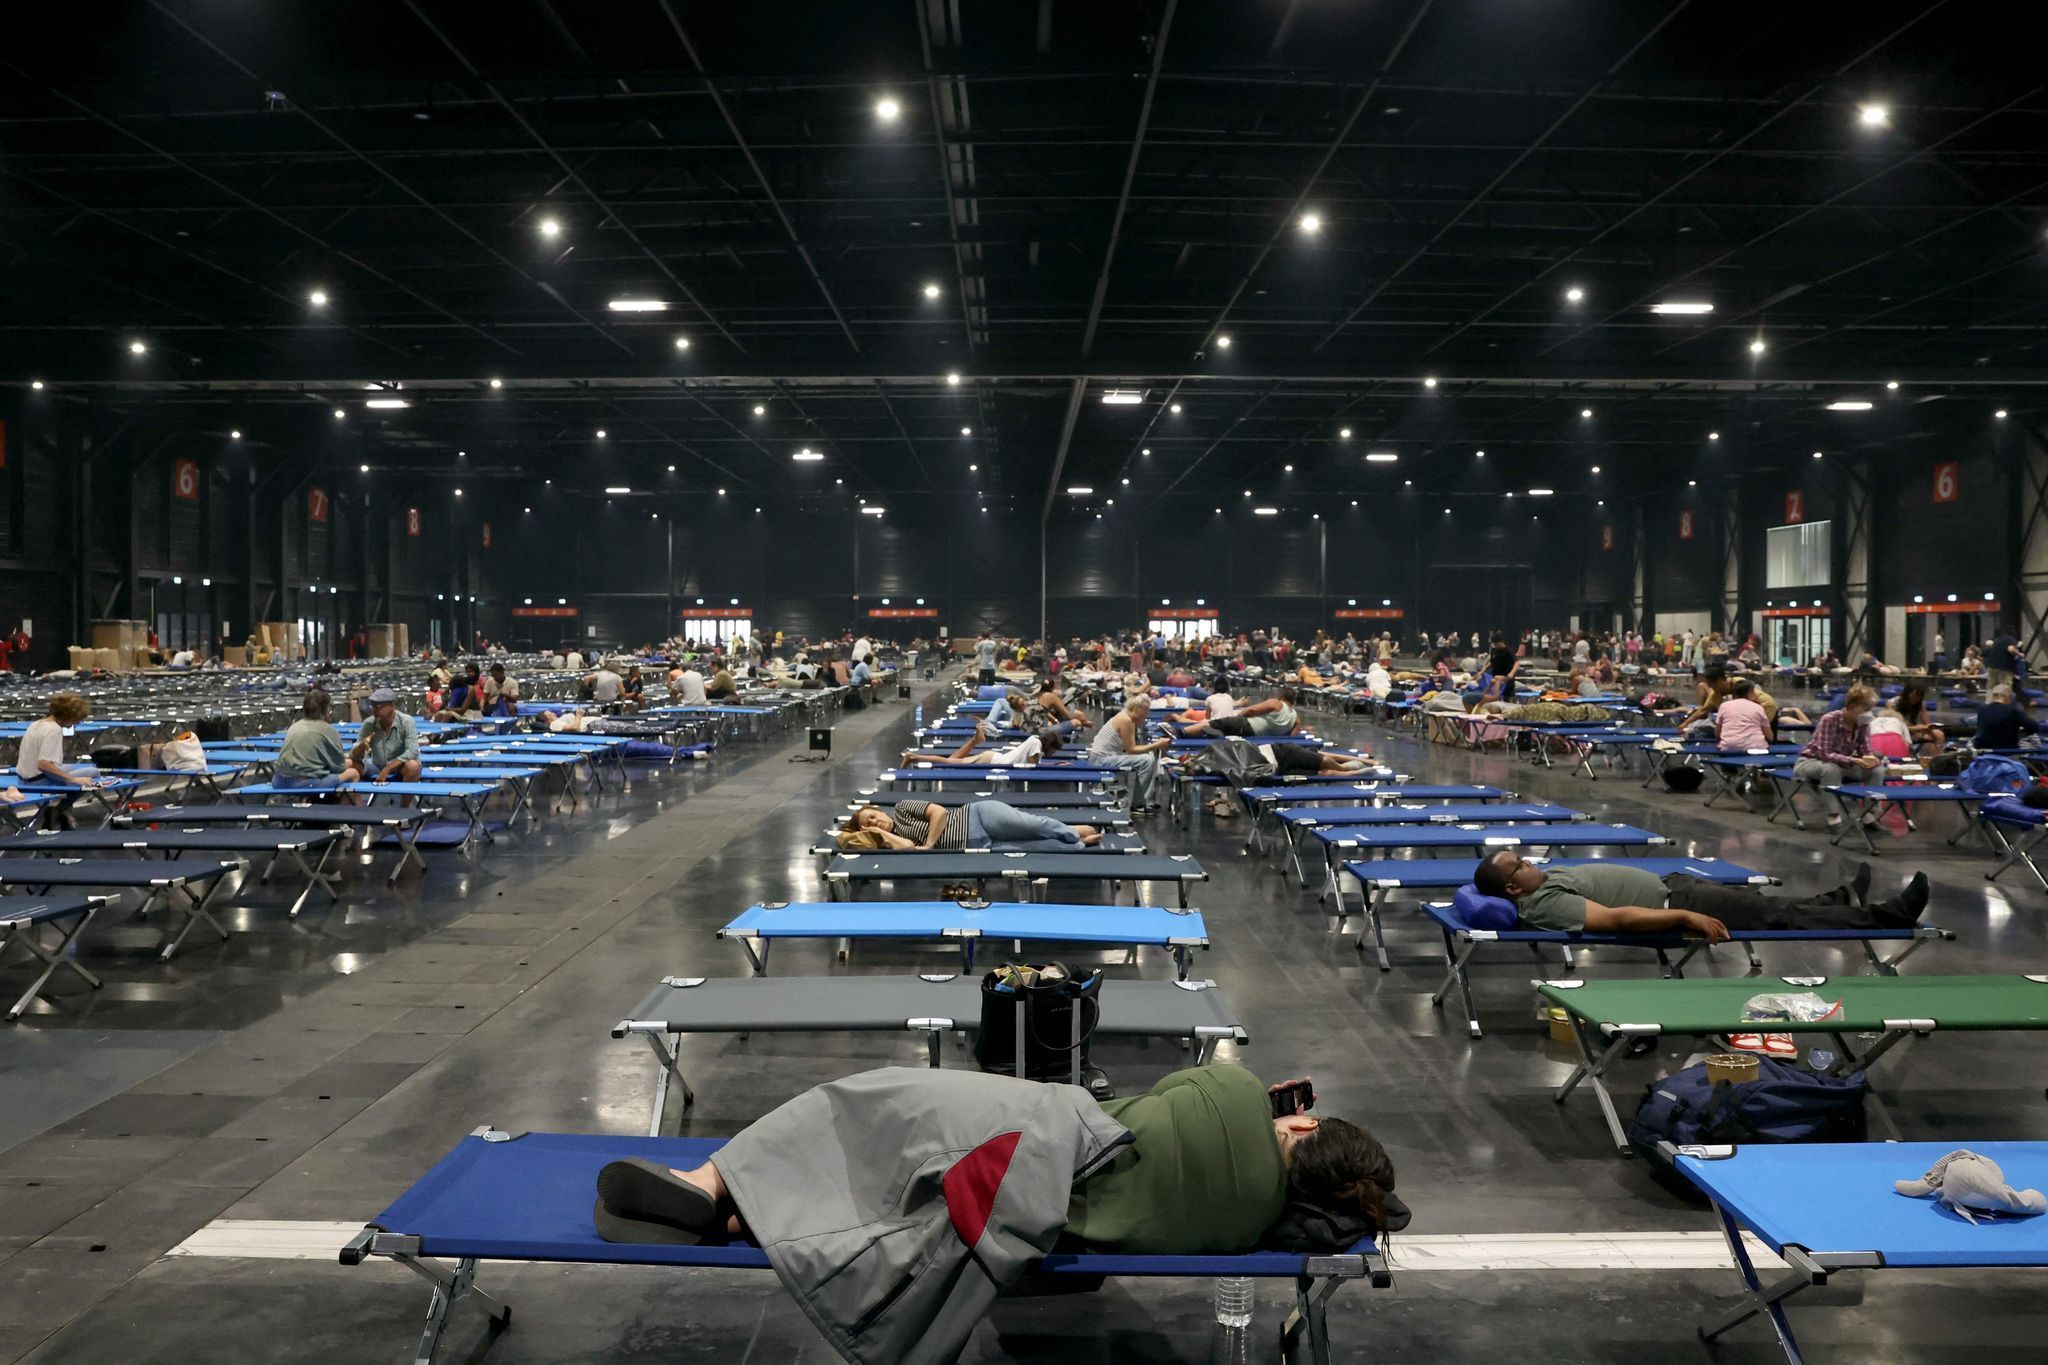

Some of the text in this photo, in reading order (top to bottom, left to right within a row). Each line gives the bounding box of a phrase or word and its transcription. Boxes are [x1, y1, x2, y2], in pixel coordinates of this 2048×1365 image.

[180, 464, 193, 495] 6
[1938, 465, 1953, 497] 6
[313, 489, 325, 516] 7
[411, 511, 418, 532] 8
[1682, 513, 1690, 536] 8
